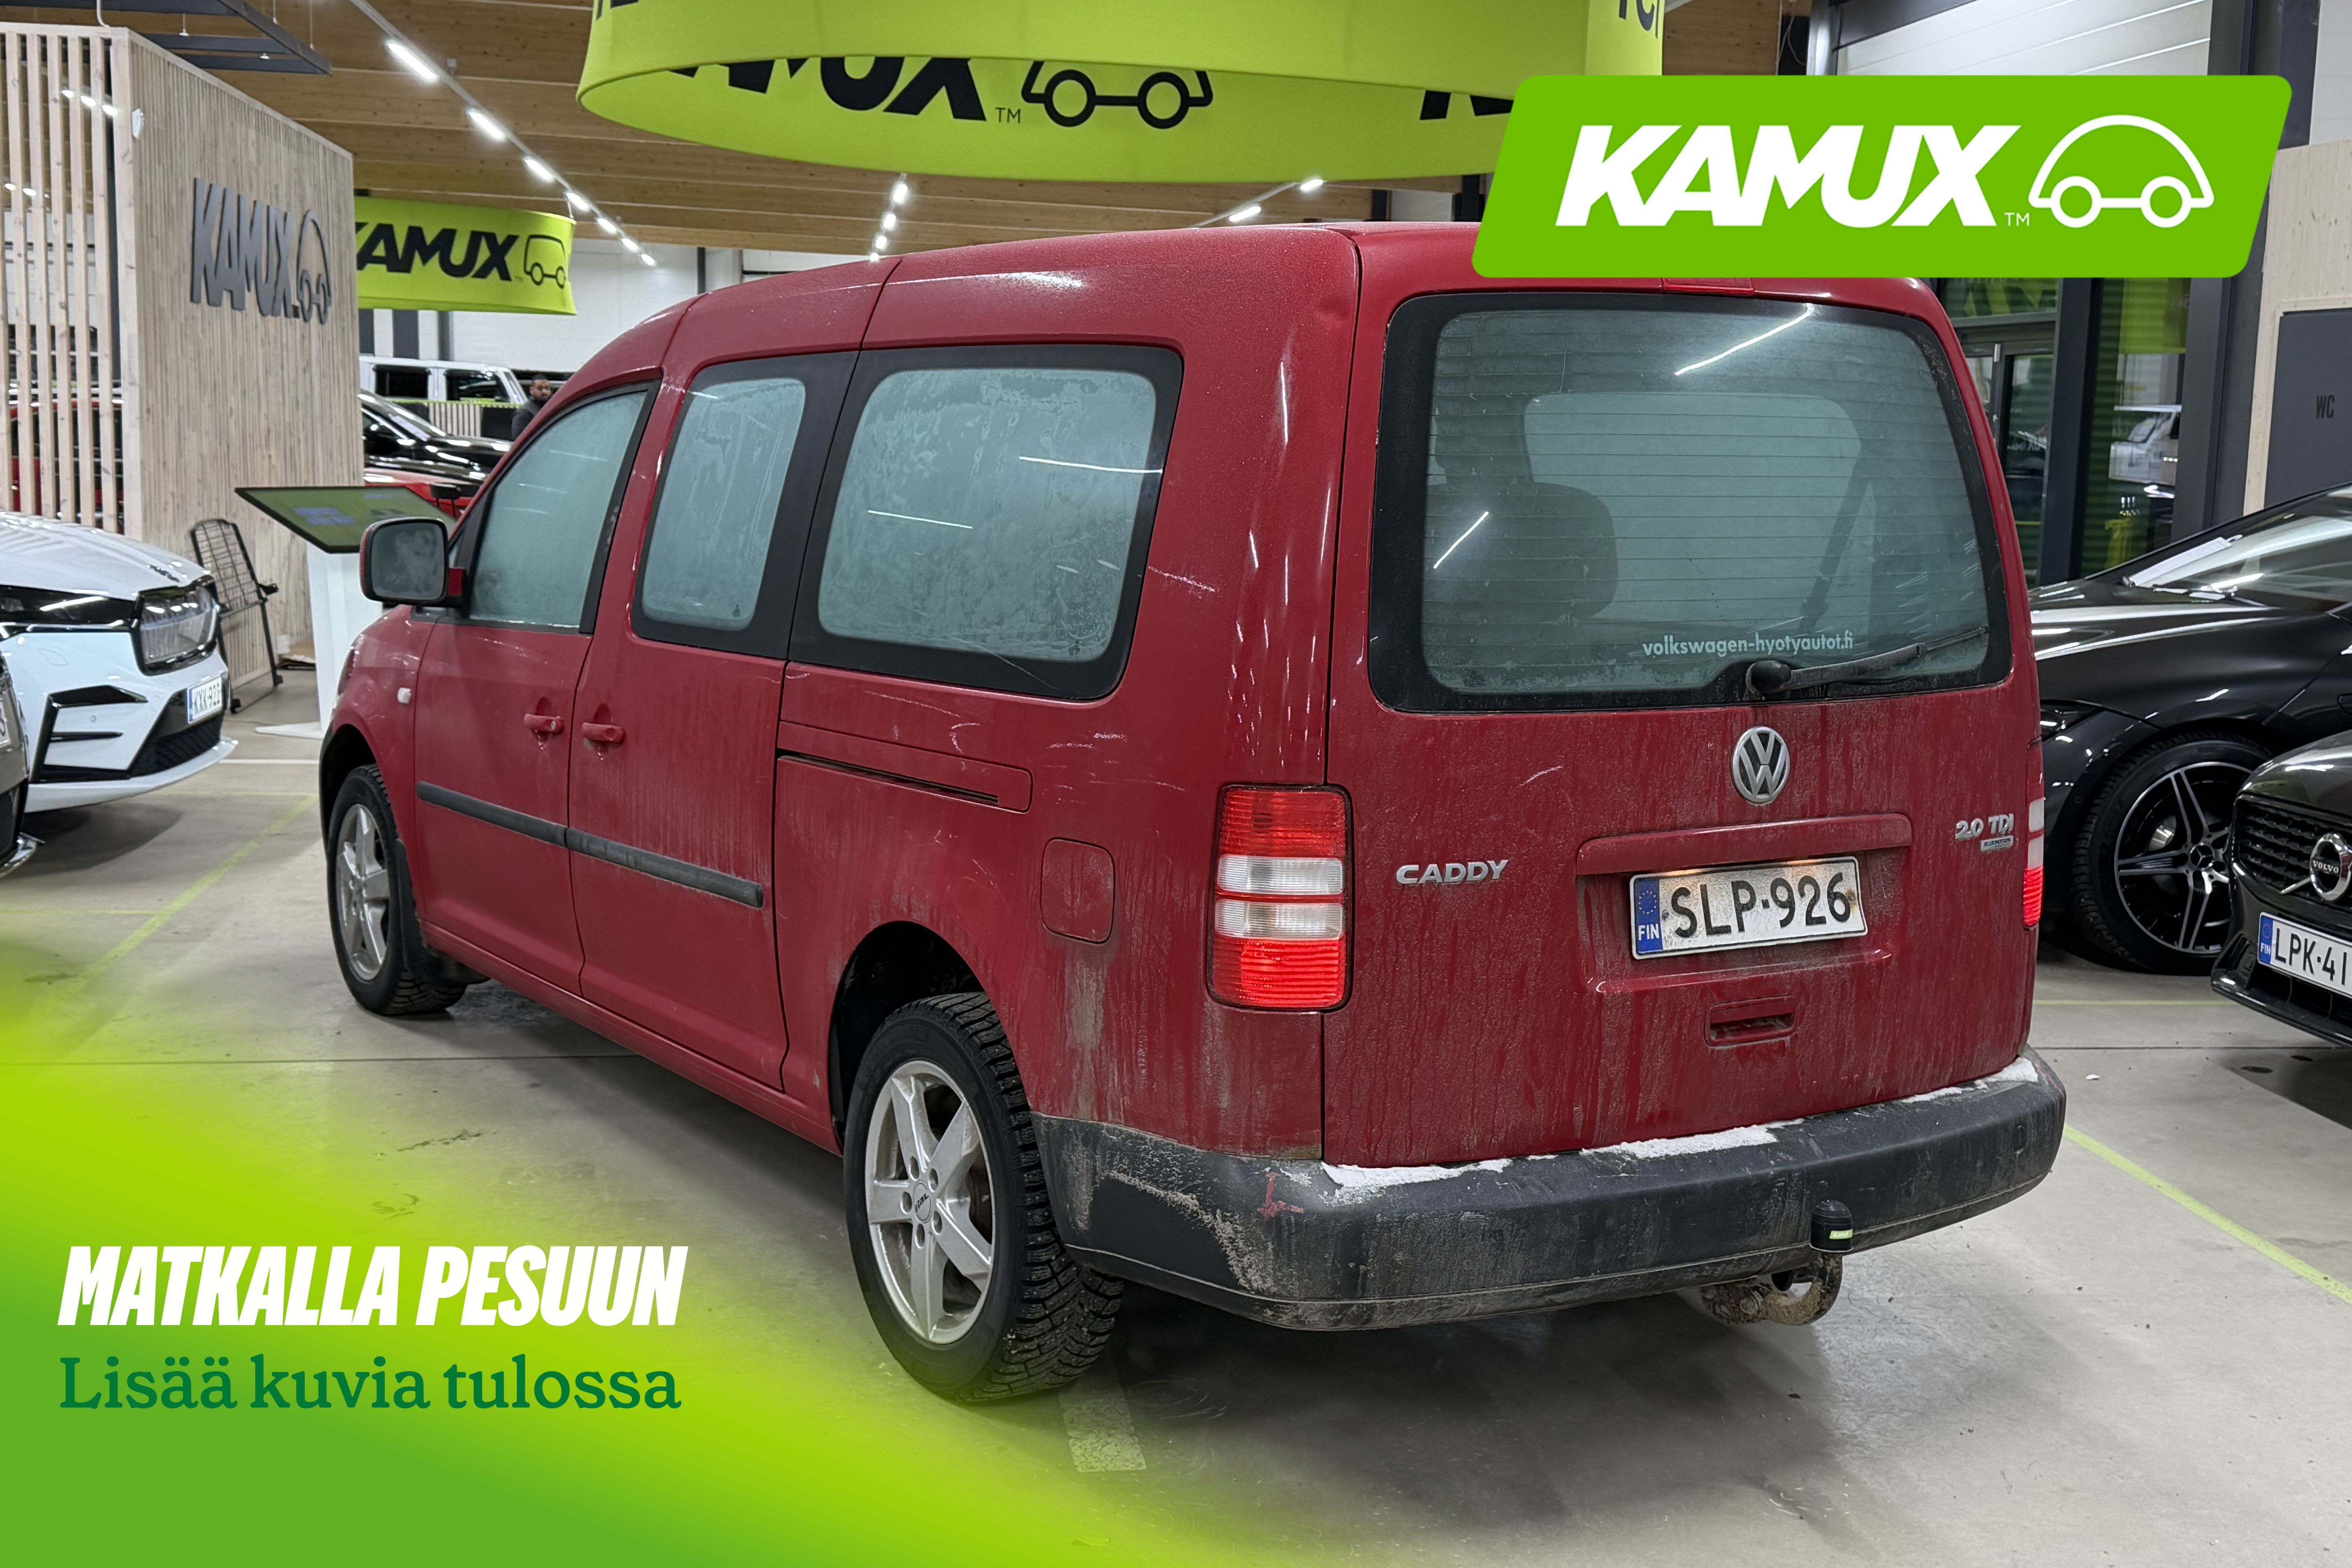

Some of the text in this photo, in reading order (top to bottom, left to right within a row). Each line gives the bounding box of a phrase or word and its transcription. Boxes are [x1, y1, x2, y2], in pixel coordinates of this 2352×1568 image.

[995, 107, 1021, 124] TM
[190, 177, 297, 318] KAMUX
[355, 222, 520, 282] AMUX
[2316, 394, 2335, 419] WC
[1642, 629, 1853, 658] volkswagen-hyotyautot.fi
[1955, 813, 2014, 839] 2.0 TDI
[1396, 859, 1509, 884] CADDY
[2312, 860, 2339, 874] VOLVO
[1638, 923, 1660, 941] FIN
[2260, 942, 2271, 956] FIN
